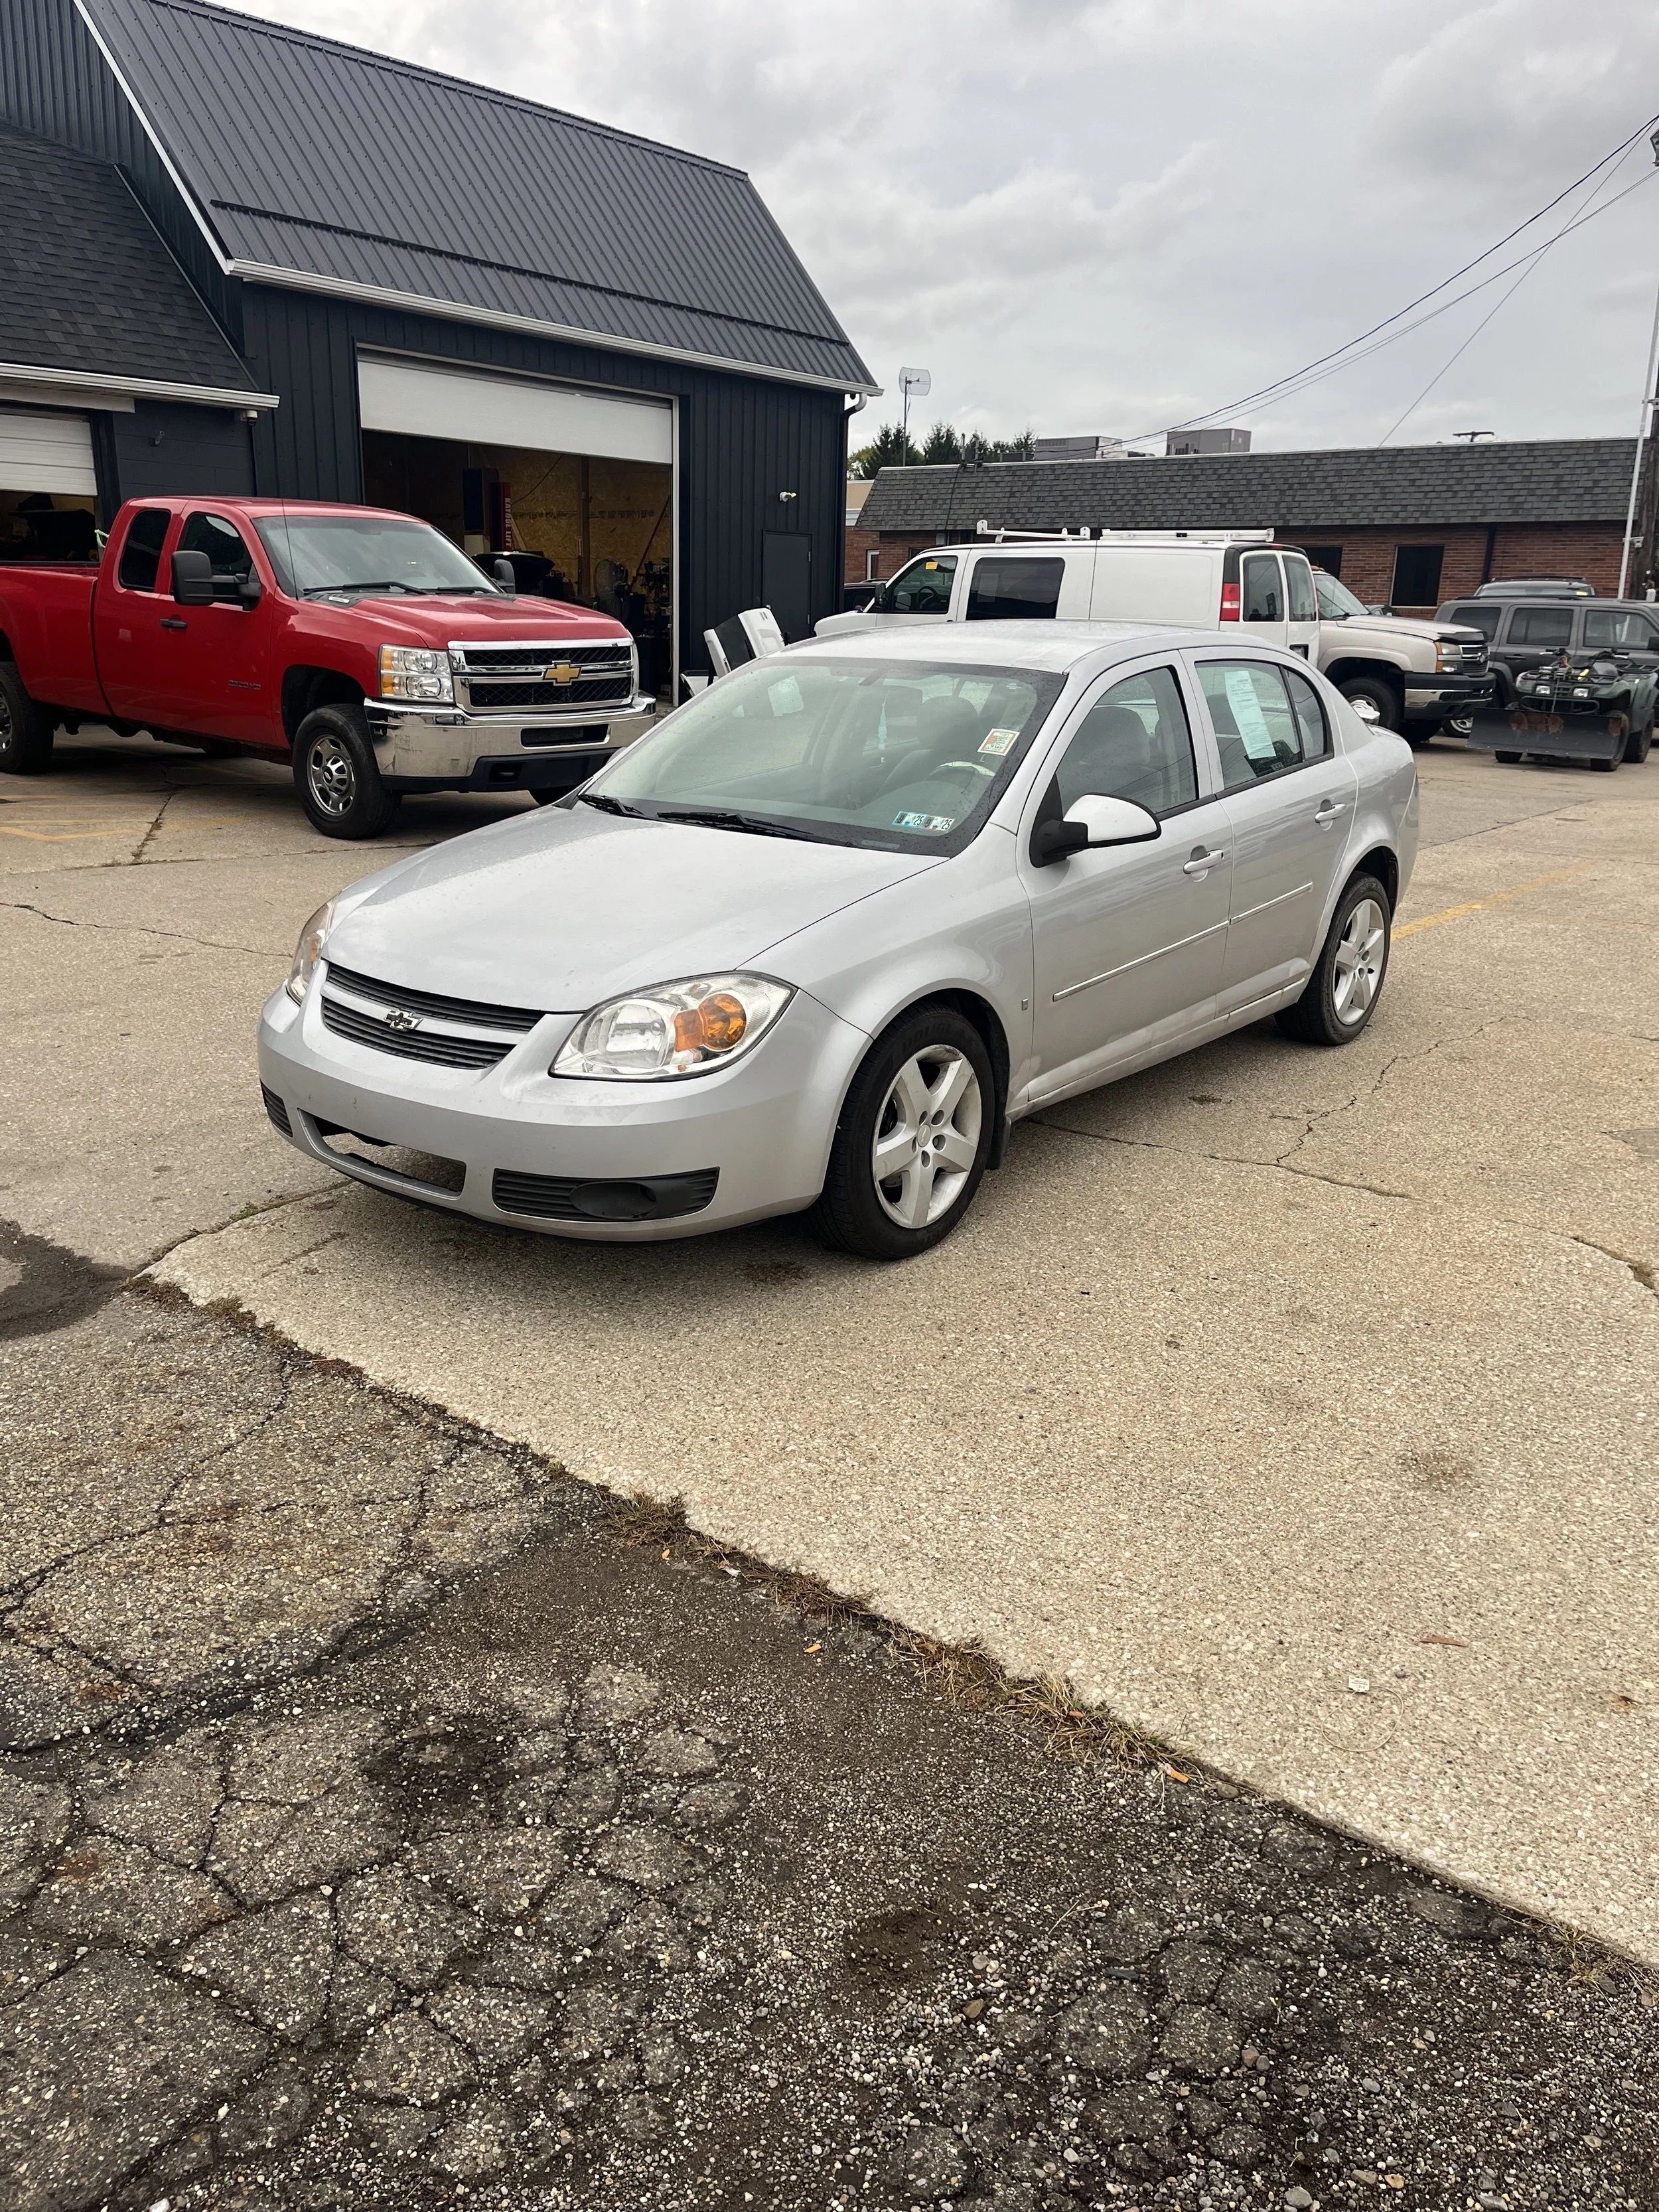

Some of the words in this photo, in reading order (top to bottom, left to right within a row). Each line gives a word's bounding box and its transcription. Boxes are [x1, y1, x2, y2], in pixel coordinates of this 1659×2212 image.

[913, 815, 925, 826] 25
[924, 818, 932, 828] 9
[941, 819, 953, 830] 25
